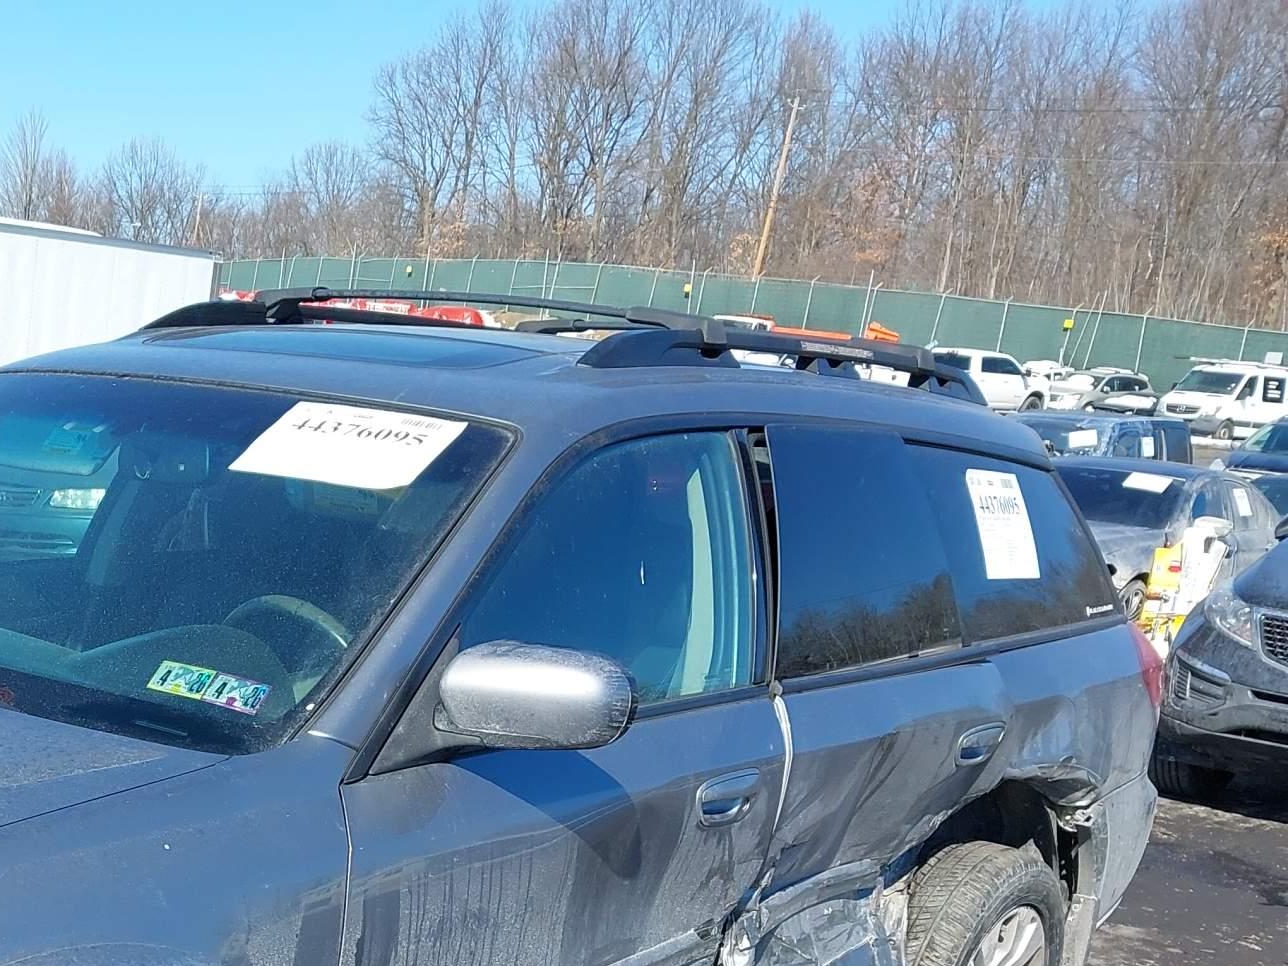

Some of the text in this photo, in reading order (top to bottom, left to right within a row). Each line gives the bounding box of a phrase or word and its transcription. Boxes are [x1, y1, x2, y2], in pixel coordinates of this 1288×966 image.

[292, 418, 429, 446] 44376095
[979, 495, 1021, 515] 44376095
[158, 669, 172, 686] 4
[212, 681, 229, 700] 4
